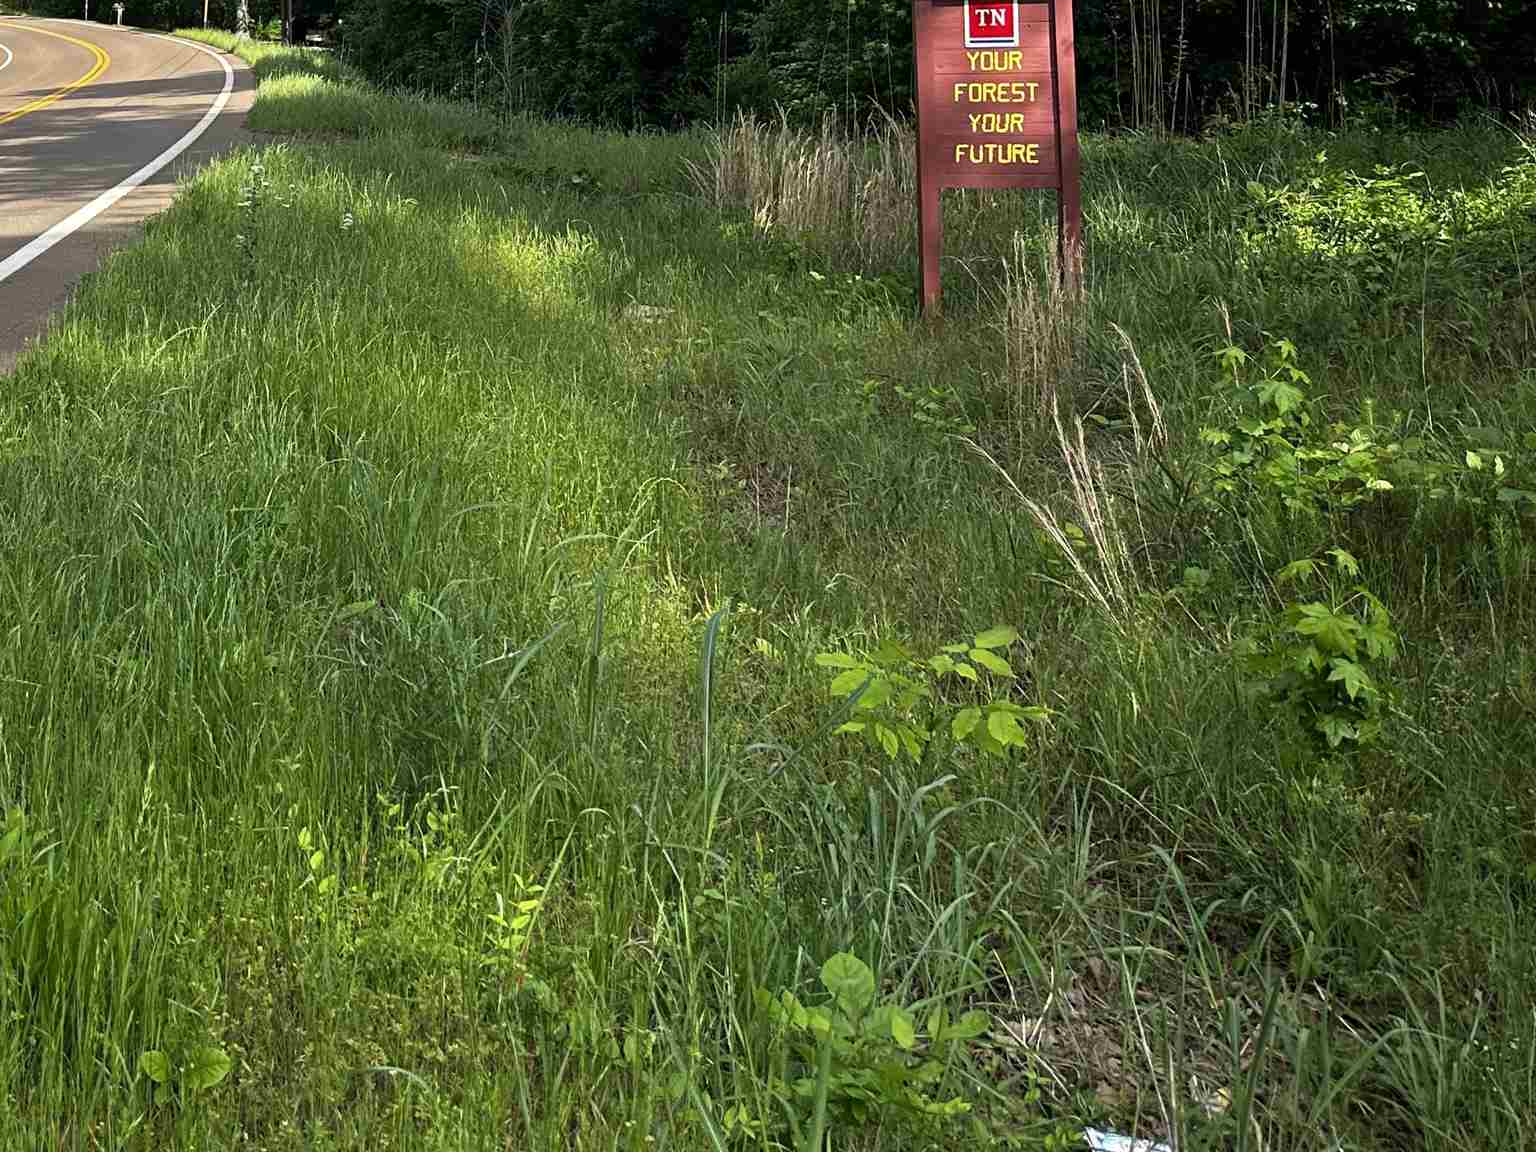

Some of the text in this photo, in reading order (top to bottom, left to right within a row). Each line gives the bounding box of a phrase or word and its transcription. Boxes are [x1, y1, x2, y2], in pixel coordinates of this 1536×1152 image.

[975, 8, 1006, 27] TN
[967, 51, 1023, 71] YOUR
[954, 82, 1039, 103] FOREST
[968, 113, 1024, 133] YOUR
[955, 143, 1040, 164] FUTURE
